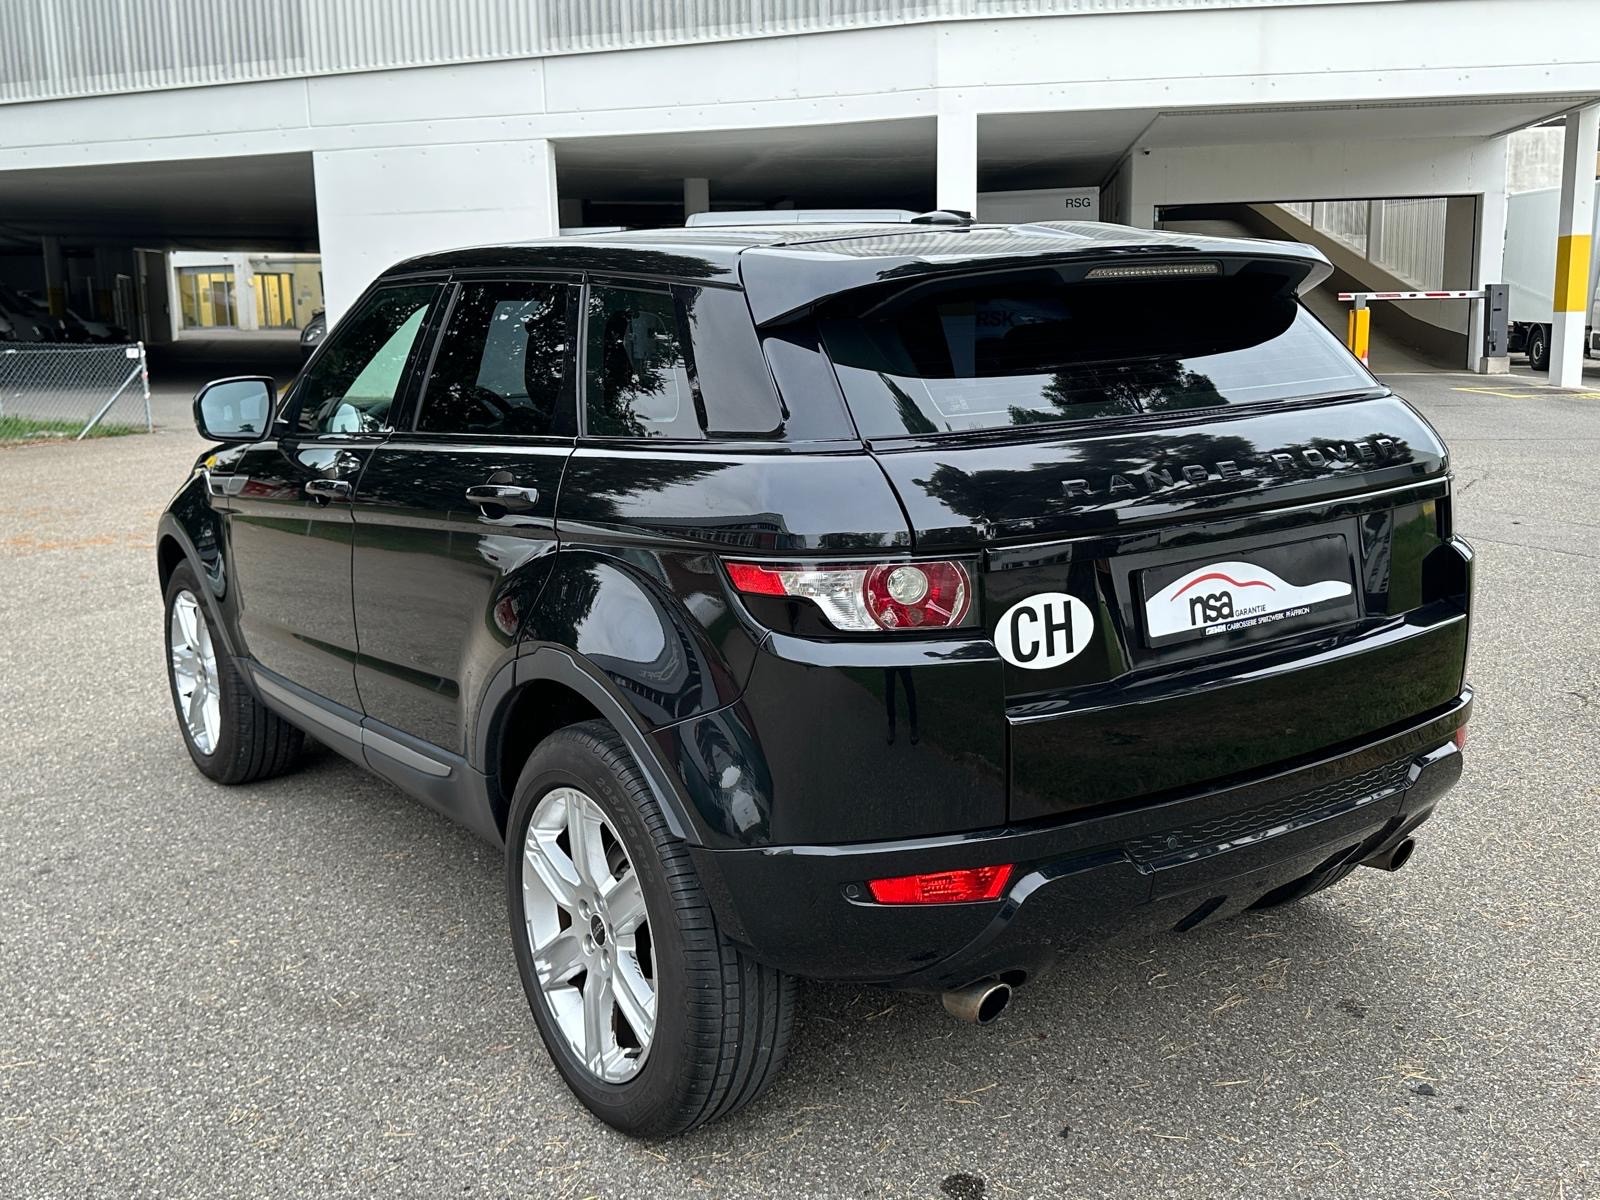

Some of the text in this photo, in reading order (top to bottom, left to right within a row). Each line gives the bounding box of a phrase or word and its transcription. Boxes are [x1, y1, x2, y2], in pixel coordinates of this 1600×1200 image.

[1065, 197, 1091, 208] RSG
[1060, 438, 1401, 498] RANGE ROVER
[1189, 591, 1266, 625] nsa GARANTIE
[1227, 619, 1257, 631] CARROSSERIE
[1010, 600, 1074, 663] CH
